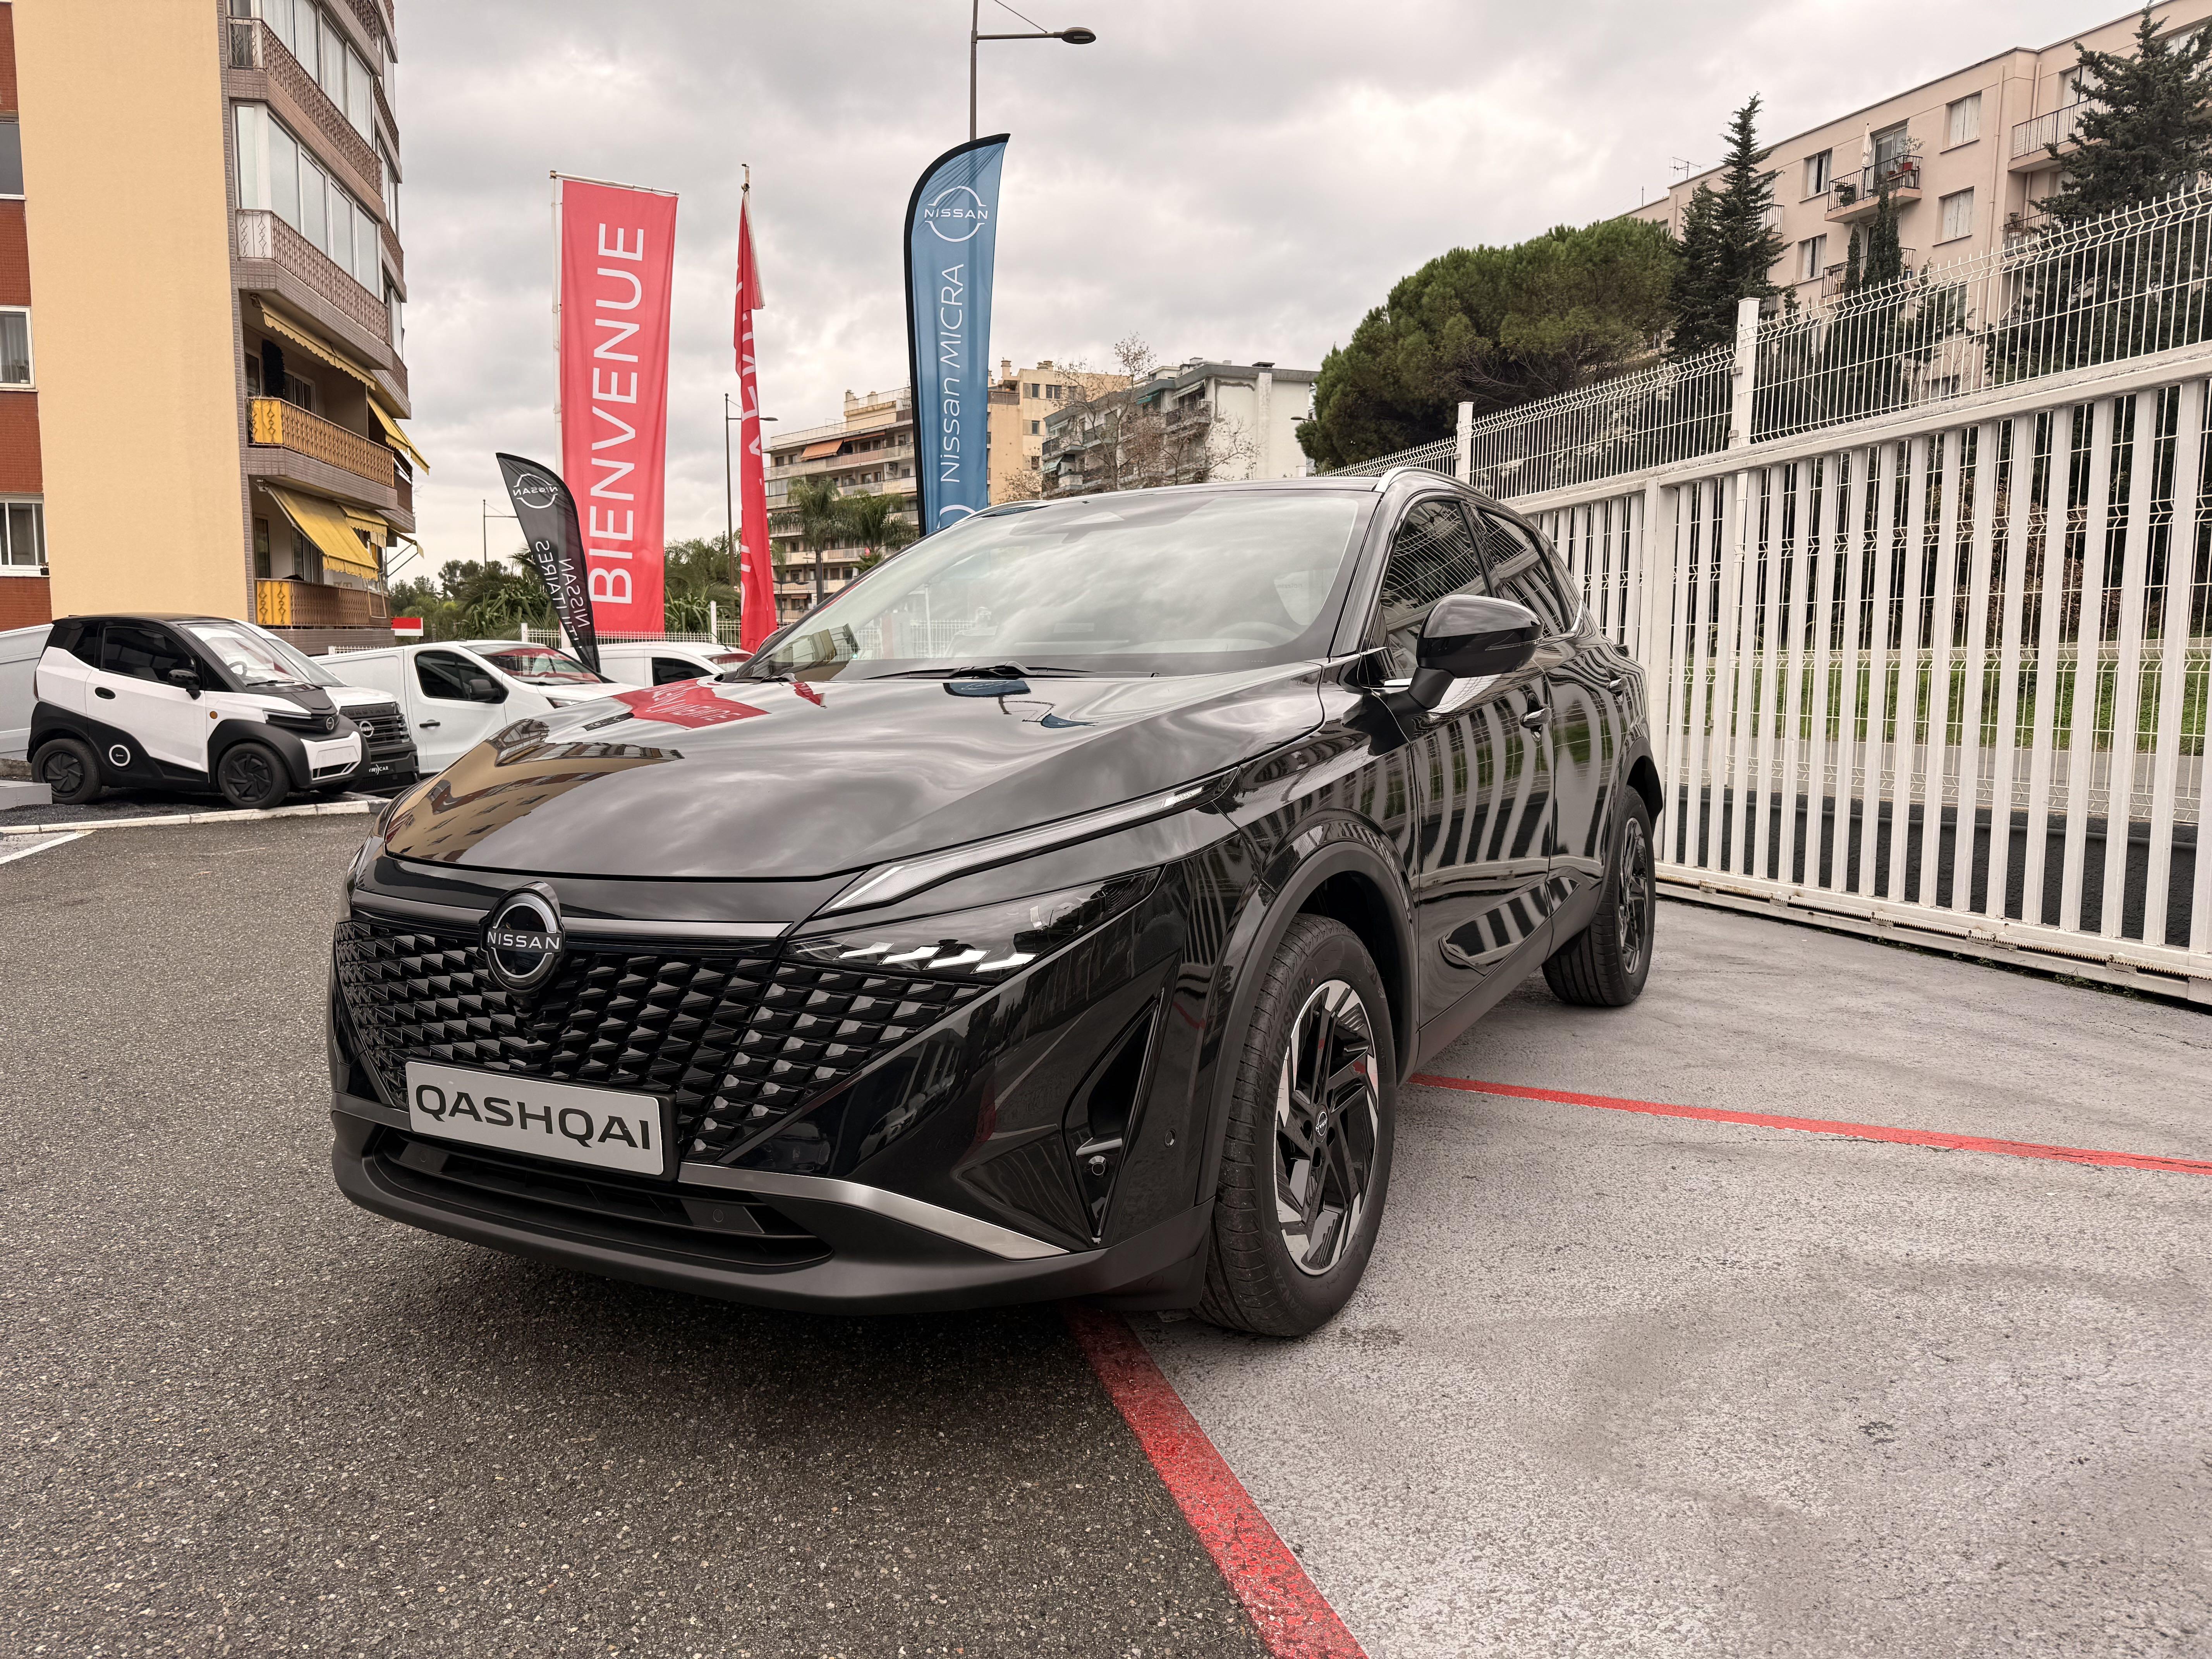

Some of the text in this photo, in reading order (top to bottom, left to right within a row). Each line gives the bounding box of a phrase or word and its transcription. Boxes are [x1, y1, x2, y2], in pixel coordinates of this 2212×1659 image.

[924, 209, 988, 219] NISSAN
[588, 223, 644, 604] BIENVENUE
[940, 264, 964, 483] Nissan MICRA
[487, 931, 560, 950] NISSAN
[1261, 967, 1312, 1125] BRIDGESTONE
[416, 1084, 651, 1150] QASHQAI
